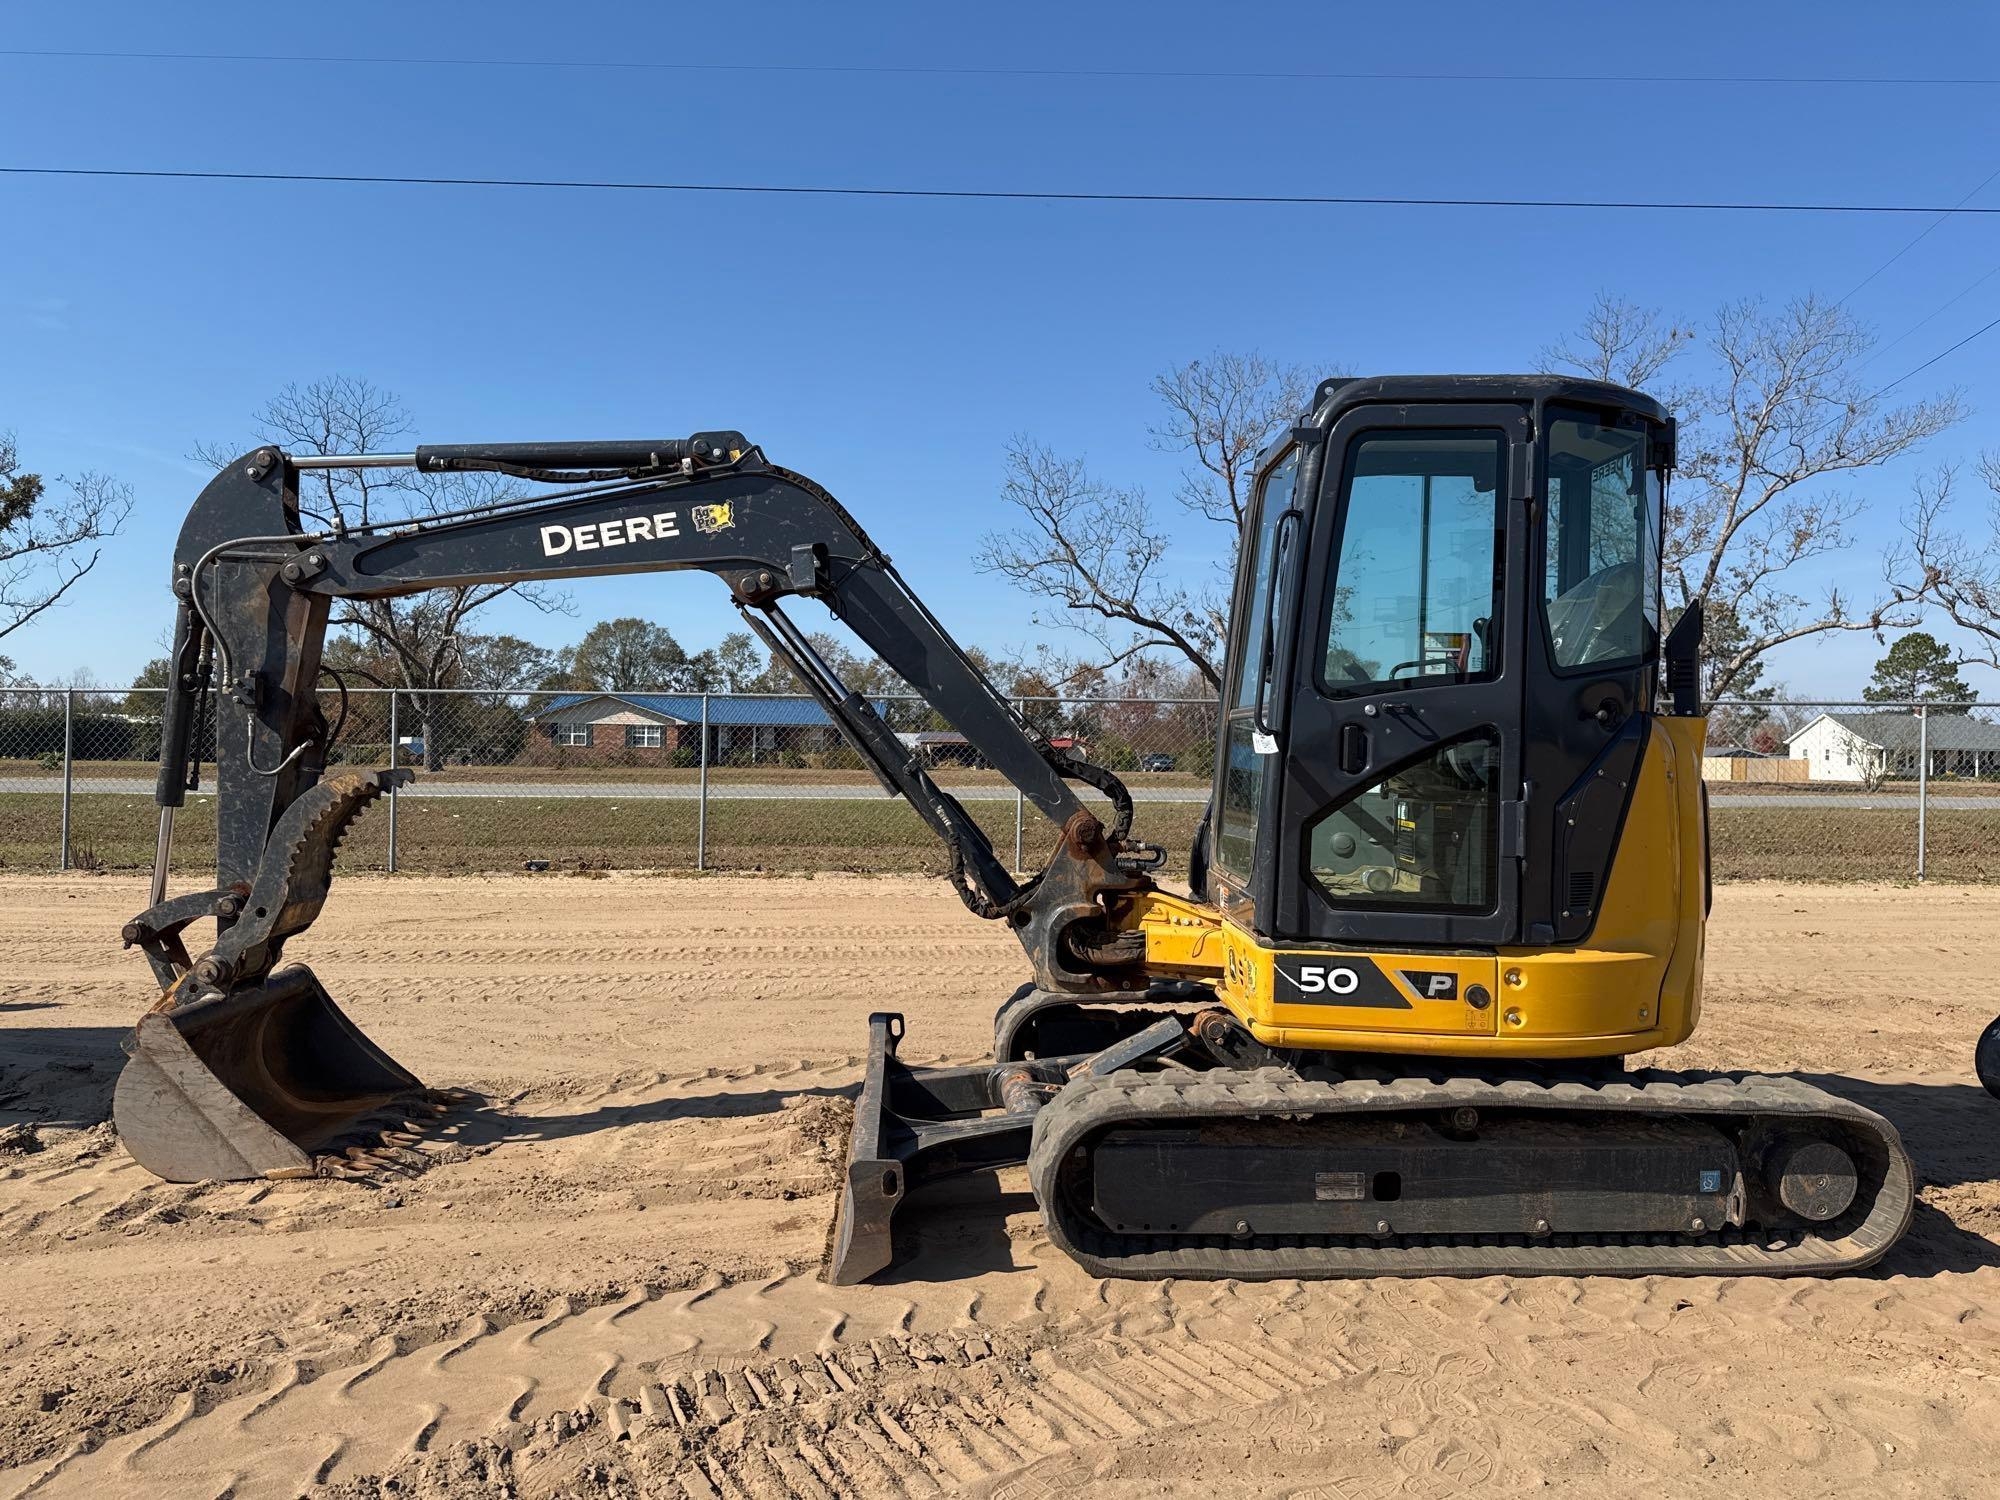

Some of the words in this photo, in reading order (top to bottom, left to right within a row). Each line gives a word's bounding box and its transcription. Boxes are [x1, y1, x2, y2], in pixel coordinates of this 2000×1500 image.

[540, 511, 680, 557] DEERE
[697, 517, 717, 529] Pro
[1300, 966, 1359, 995] 50
[1427, 975, 1452, 996] P
